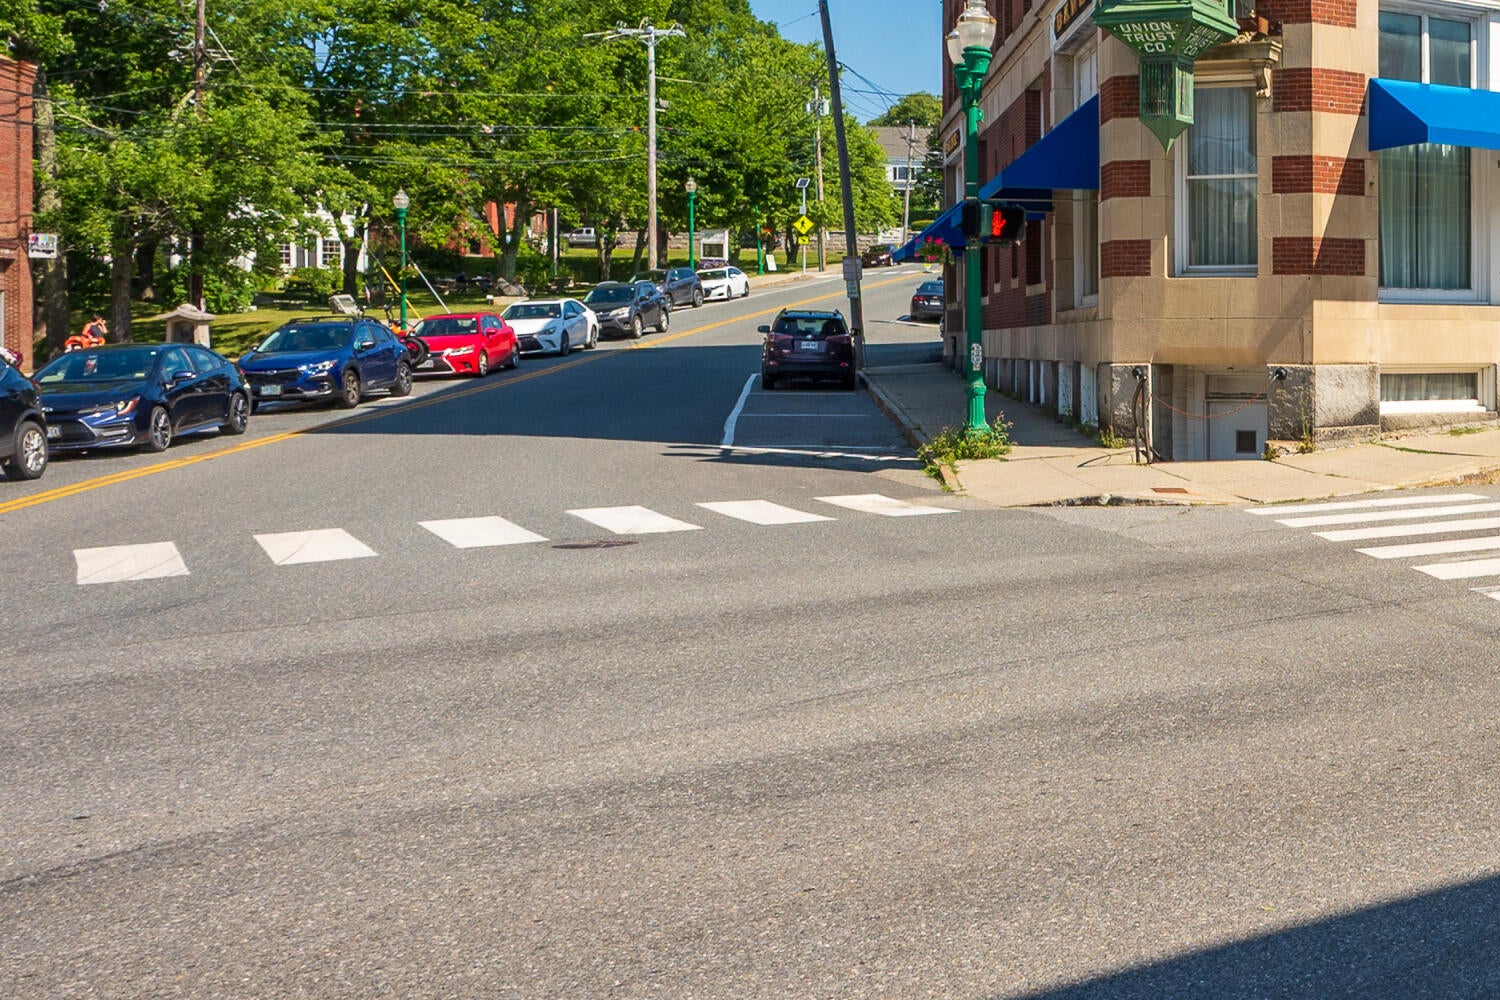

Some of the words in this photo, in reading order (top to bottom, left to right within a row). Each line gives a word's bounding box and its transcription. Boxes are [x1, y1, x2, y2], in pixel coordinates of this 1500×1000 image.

[1119, 21, 1173, 34] UNION
[1123, 31, 1177, 43] TRUST
[1143, 42, 1167, 53] CO
